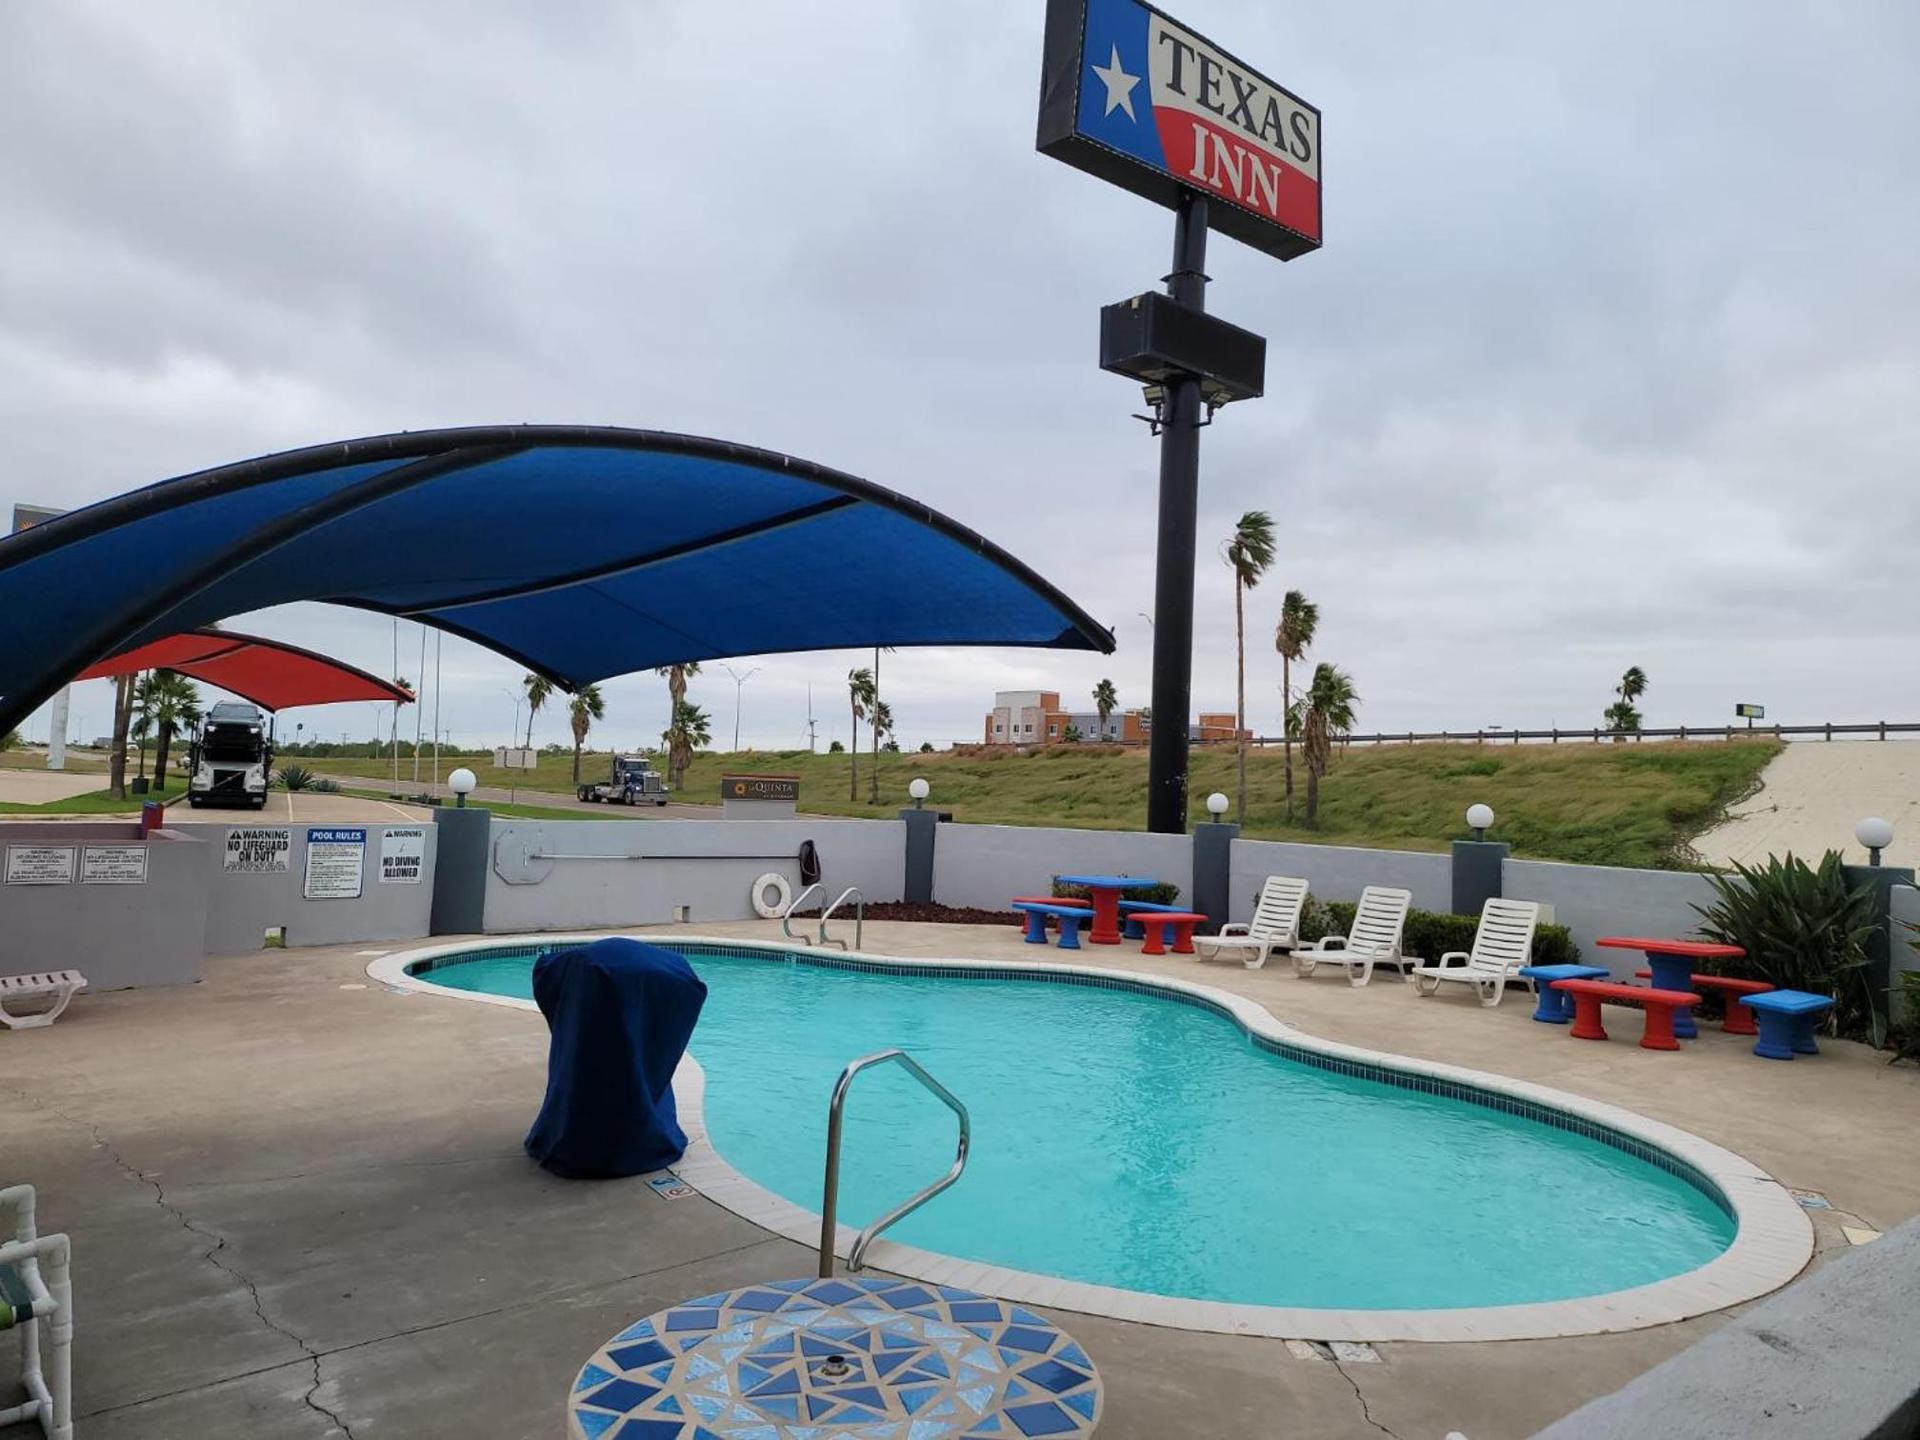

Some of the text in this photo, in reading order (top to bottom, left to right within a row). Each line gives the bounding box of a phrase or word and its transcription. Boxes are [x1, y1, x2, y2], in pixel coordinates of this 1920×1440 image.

[1159, 31, 1312, 162] TEXAS
[1189, 122, 1282, 216] INN
[755, 782, 793, 793] QUINTA
[242, 830, 288, 840] WARNING
[312, 831, 361, 840] POOL RULES
[228, 840, 288, 851] NO LIFEGUARD
[239, 851, 276, 861] ON DUTY
[383, 856, 420, 867] NO DIVING
[384, 867, 418, 878] ALLOWED
